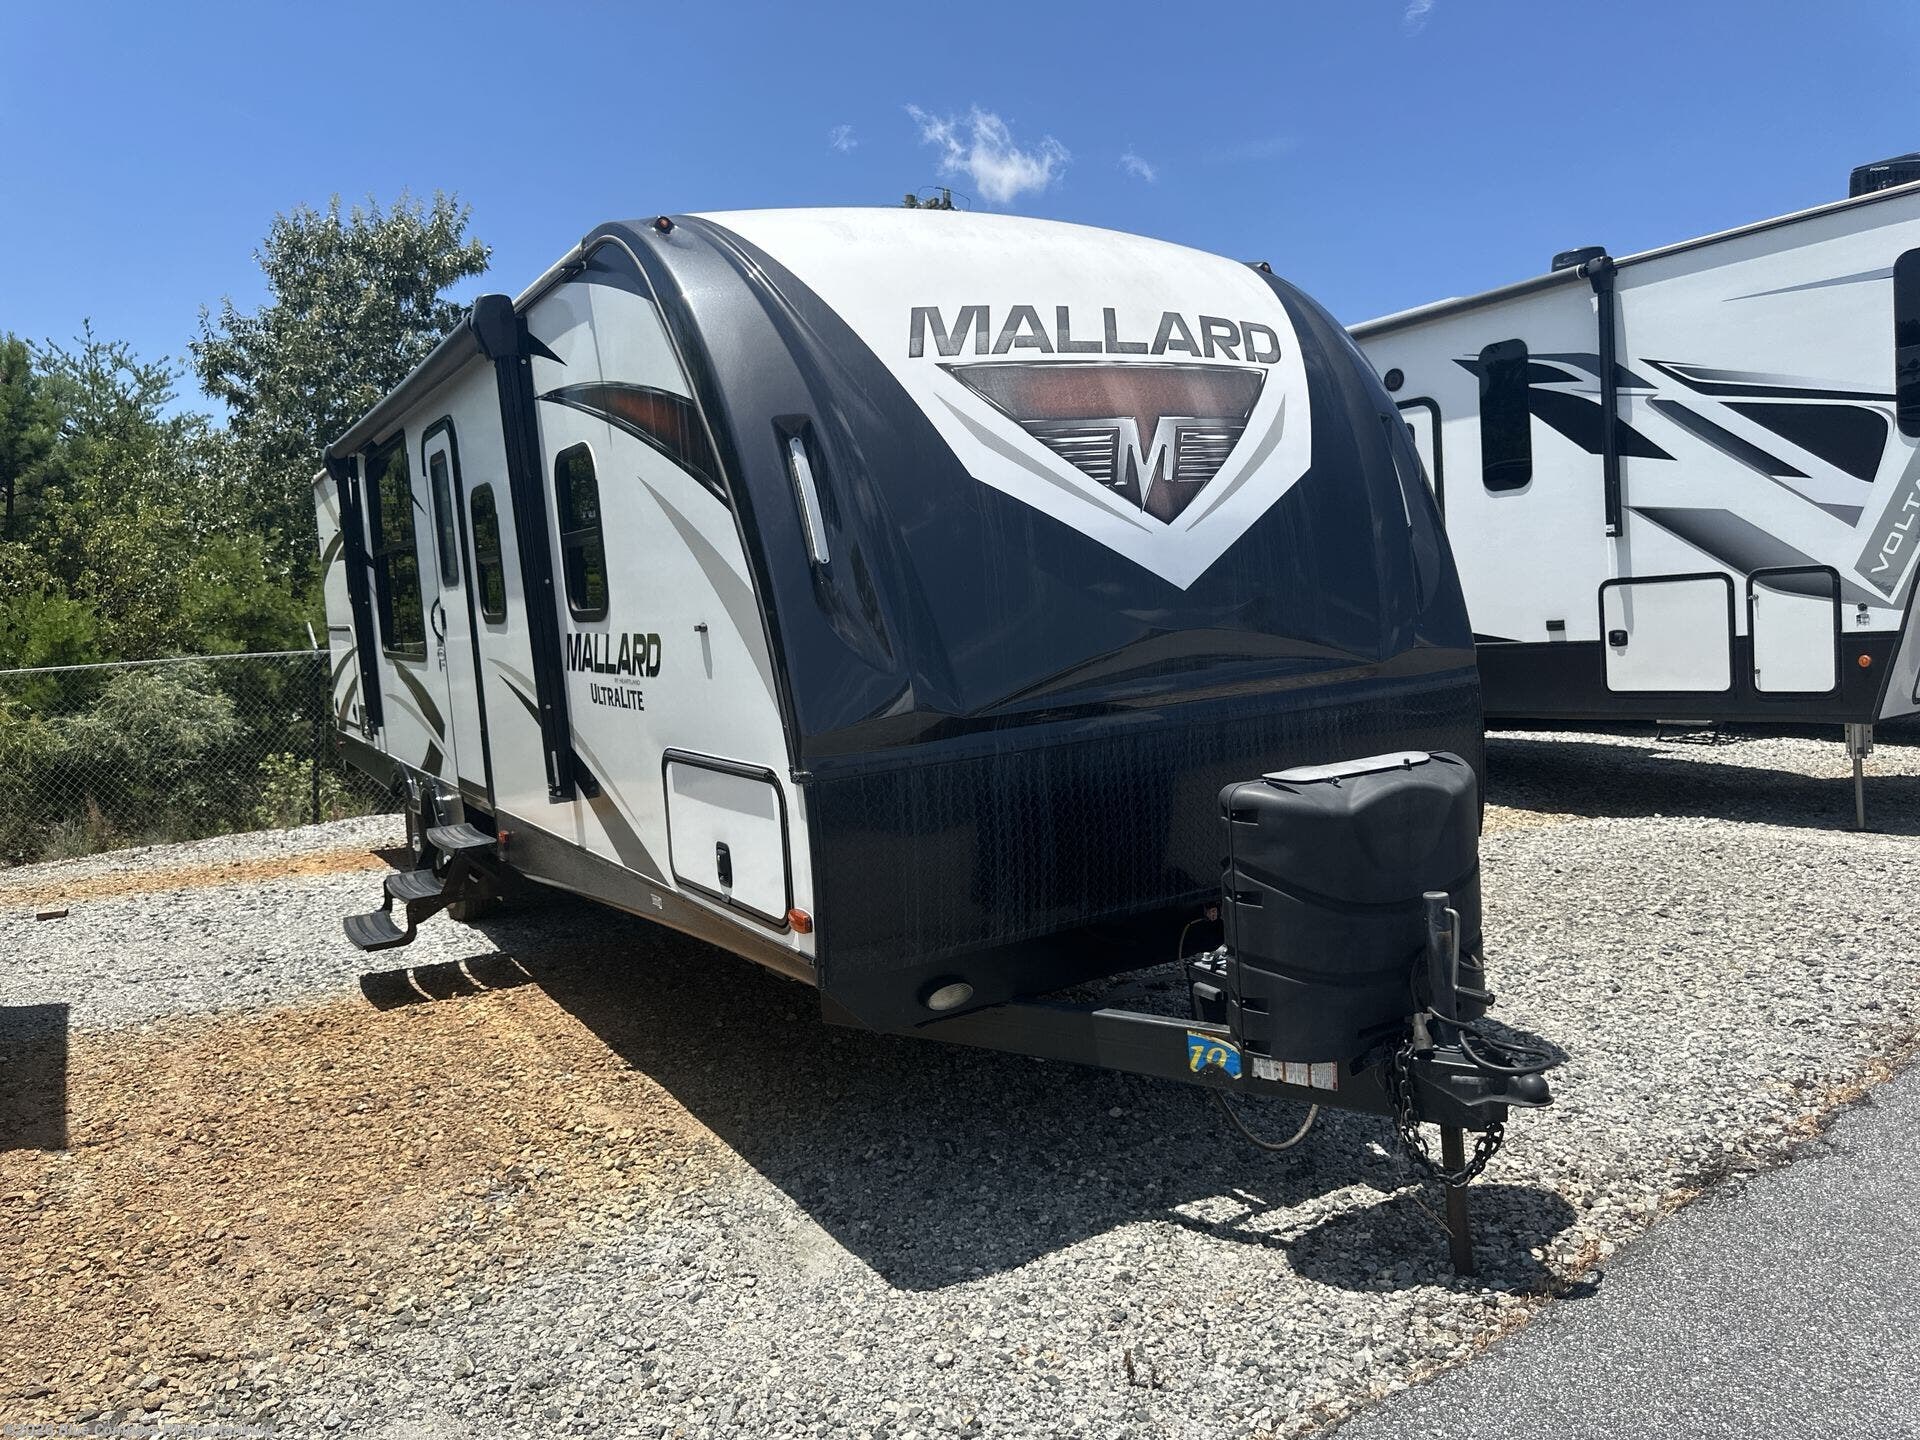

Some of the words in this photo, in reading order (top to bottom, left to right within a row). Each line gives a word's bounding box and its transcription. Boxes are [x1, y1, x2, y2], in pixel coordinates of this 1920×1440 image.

[908, 304, 1282, 364] MALLARD
[1113, 416, 1177, 514] M
[566, 633, 662, 678] MALLARD
